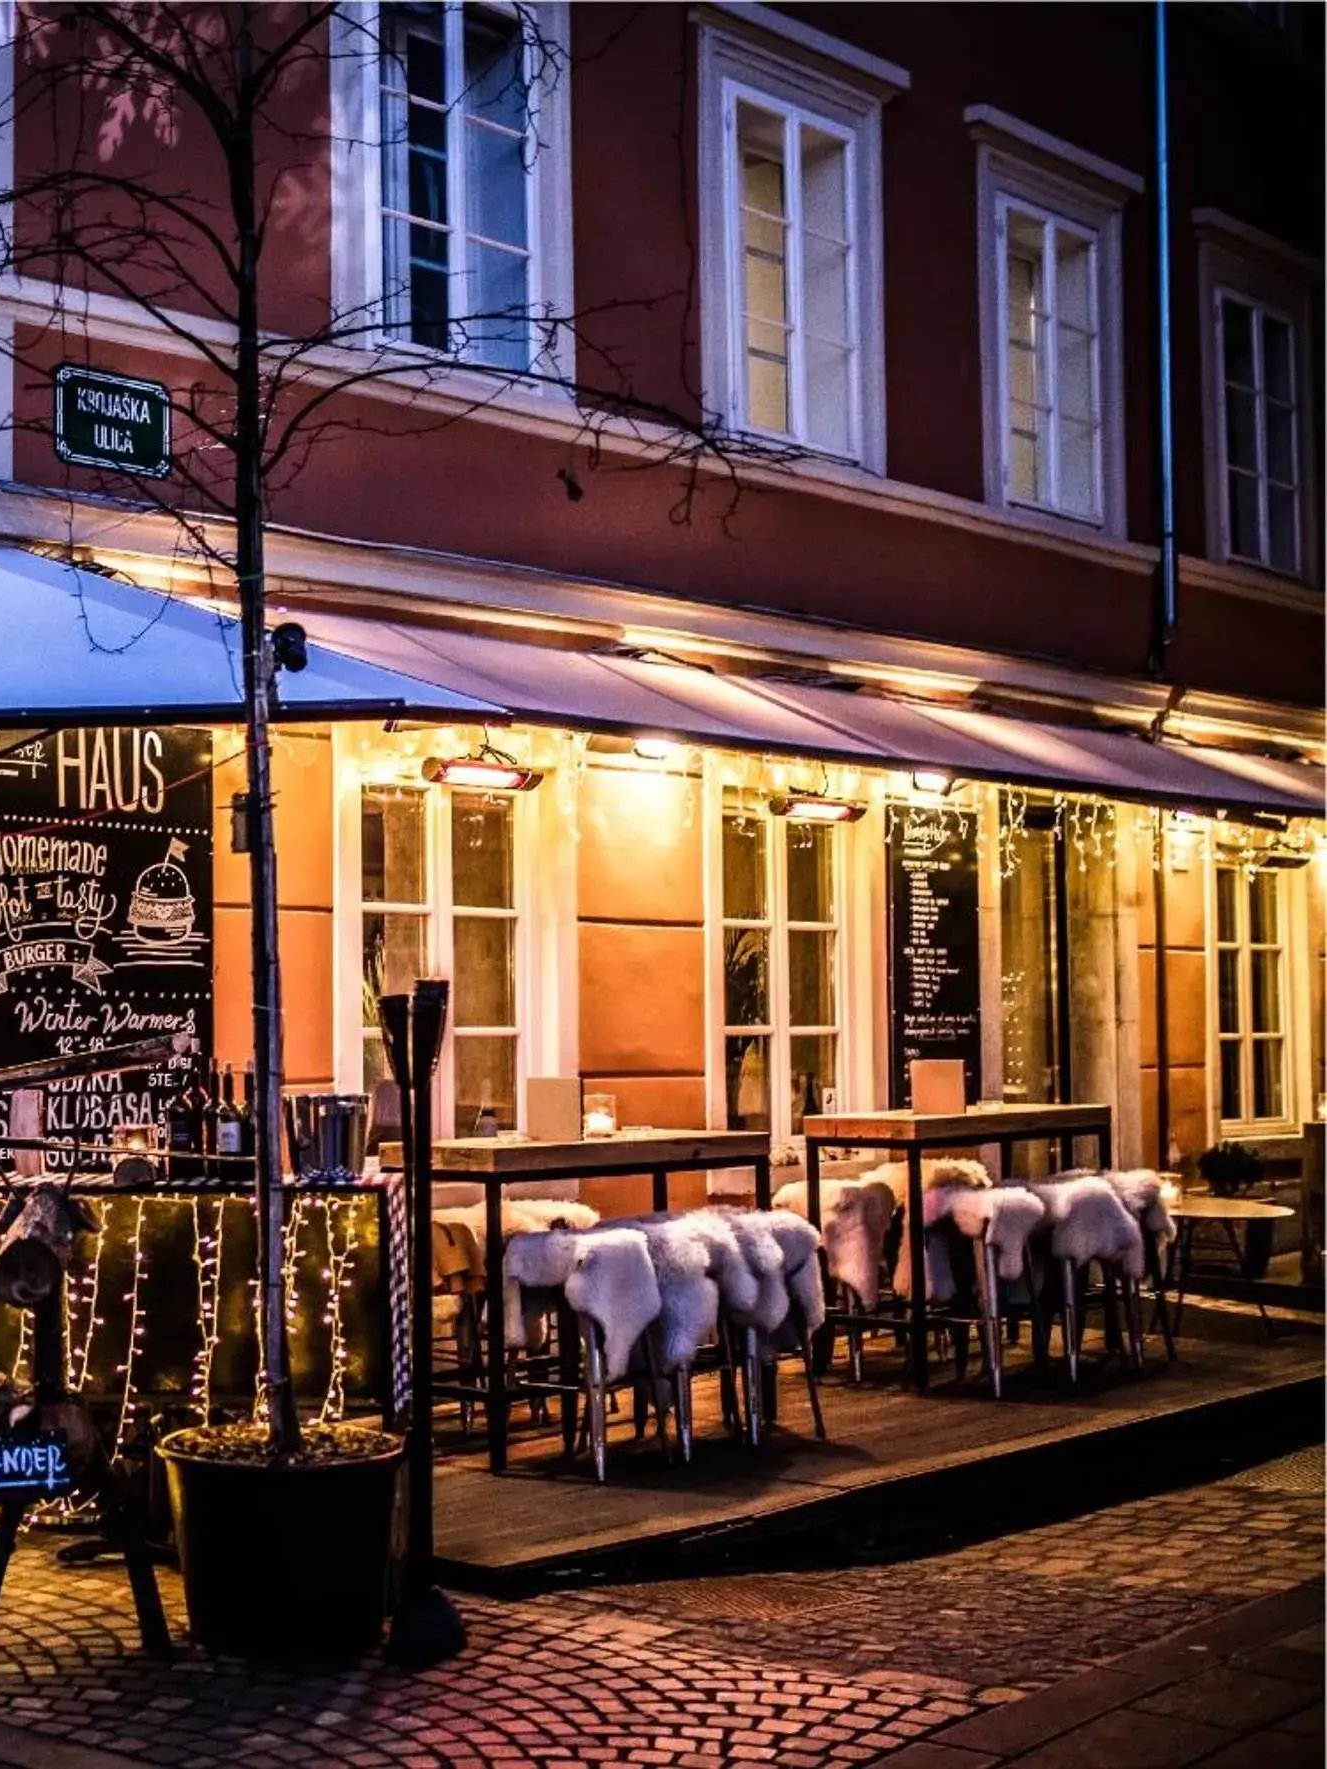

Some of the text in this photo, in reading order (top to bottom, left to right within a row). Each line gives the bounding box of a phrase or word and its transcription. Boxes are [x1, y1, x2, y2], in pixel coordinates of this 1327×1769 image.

[77, 387, 151, 424] KROJAŠKA
[94, 424, 134, 454] ULICA
[57, 727, 165, 814] HAUS
[53, 874, 117, 940] tasty
[4, 943, 67, 968] BURGER
[14, 996, 196, 1034] Winter Warmers
[46, 1091, 153, 1131] KLOBASA
